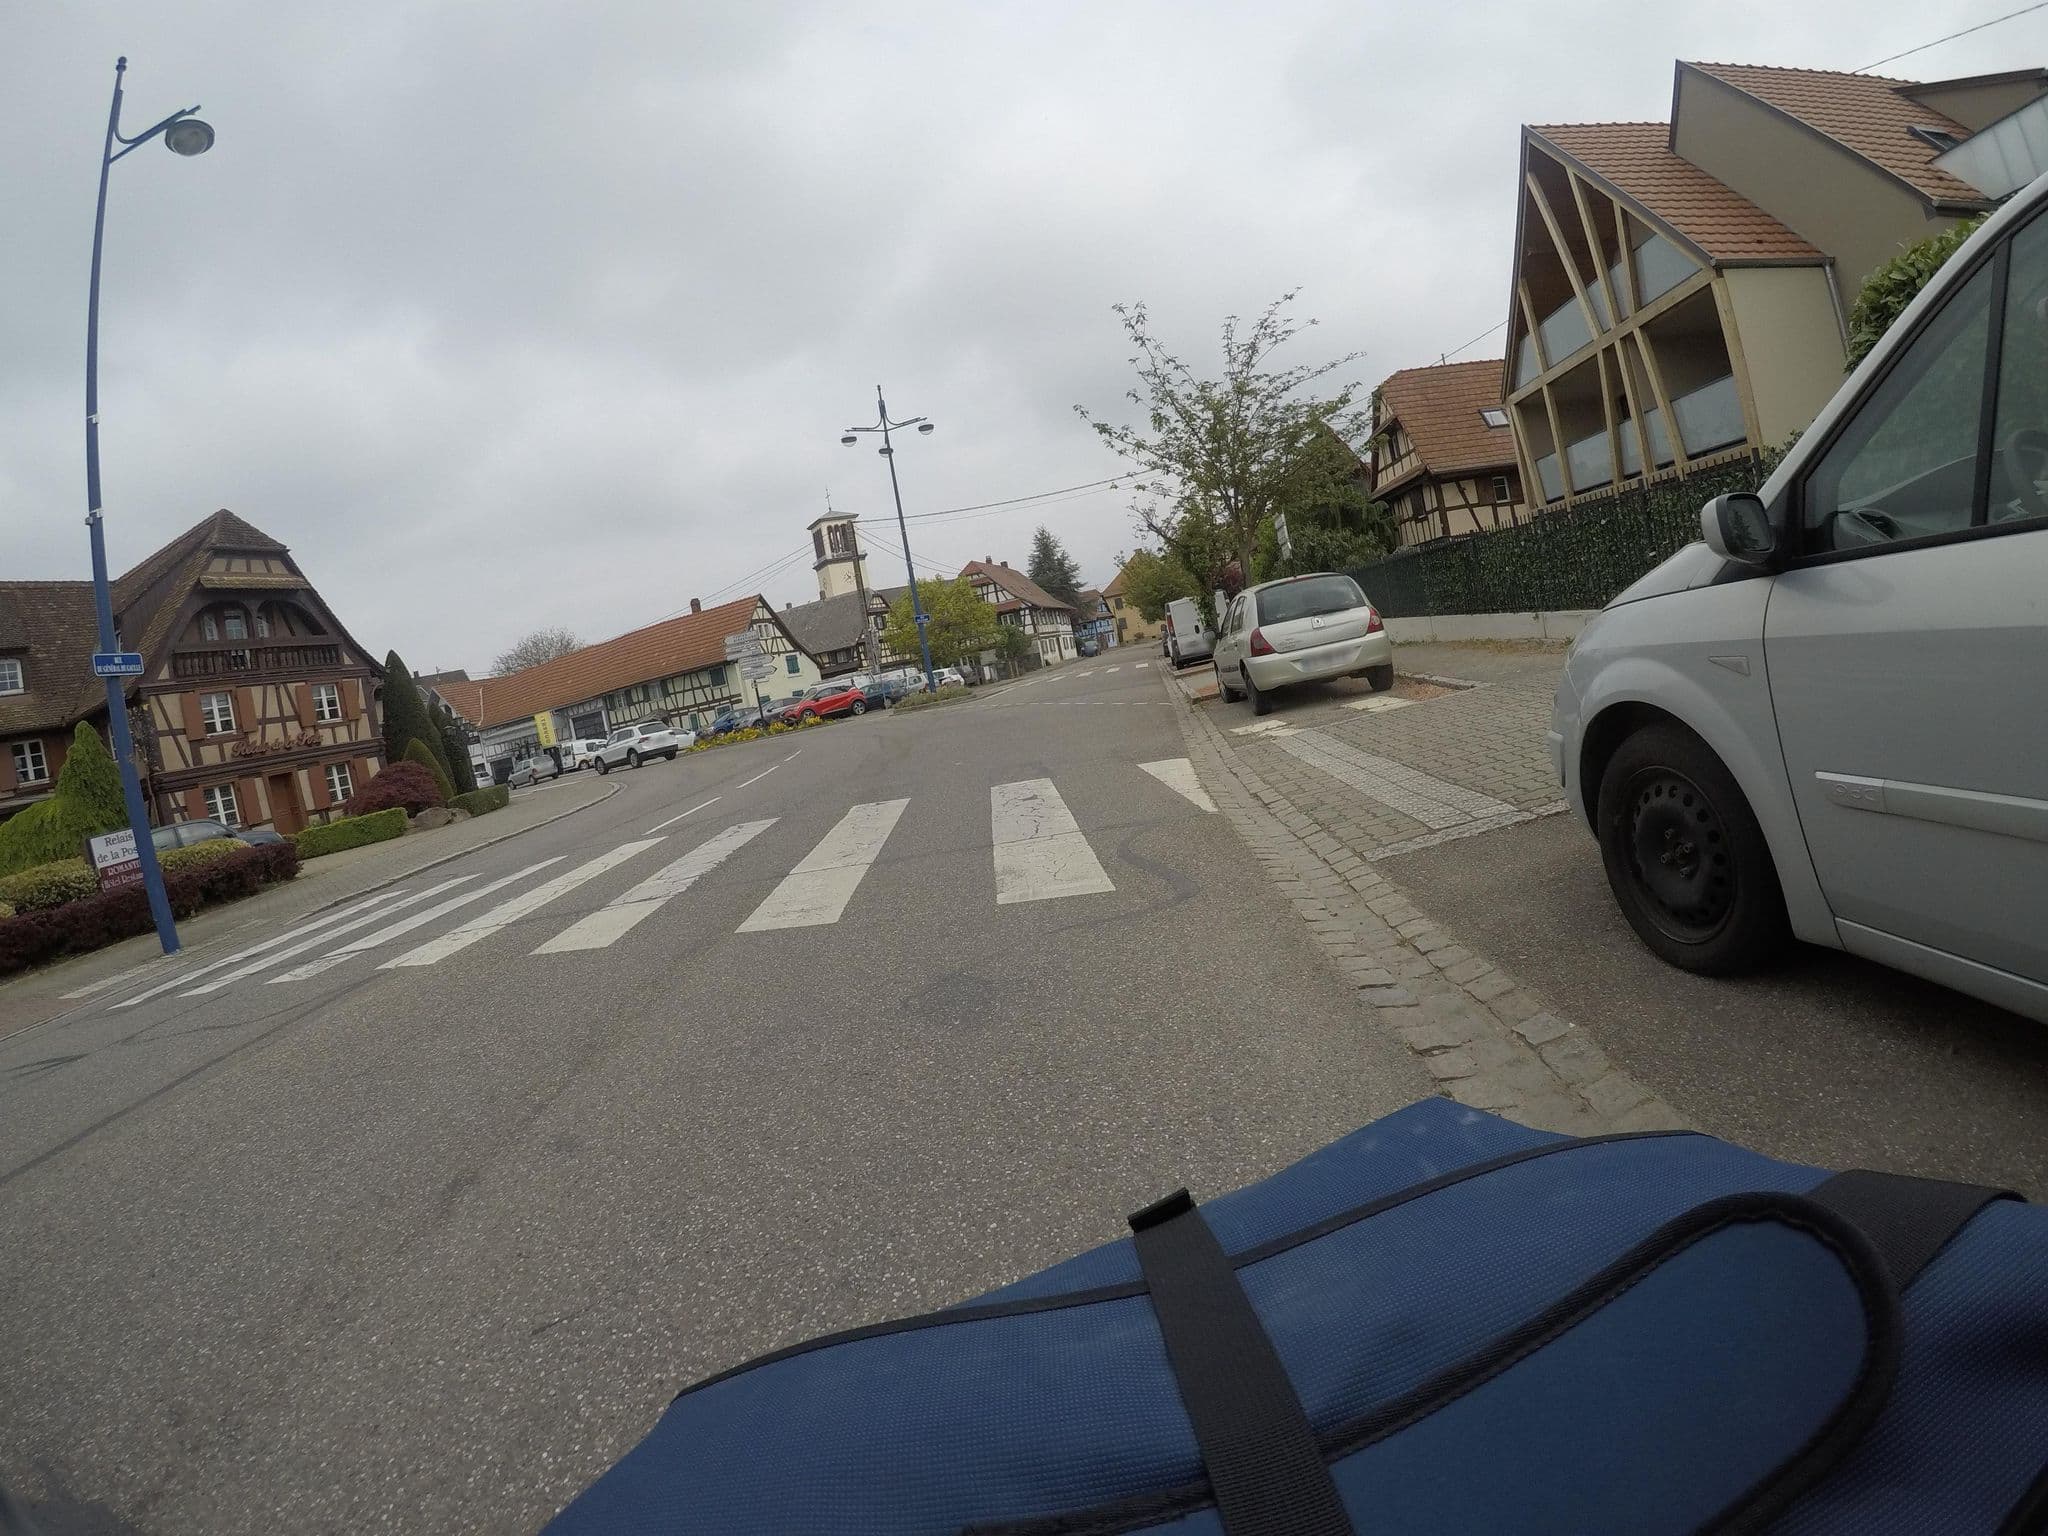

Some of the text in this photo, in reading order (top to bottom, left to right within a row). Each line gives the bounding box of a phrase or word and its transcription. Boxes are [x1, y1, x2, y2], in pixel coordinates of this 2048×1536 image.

[104, 833, 134, 847] Relais
[97, 847, 138, 864] de la Pos
